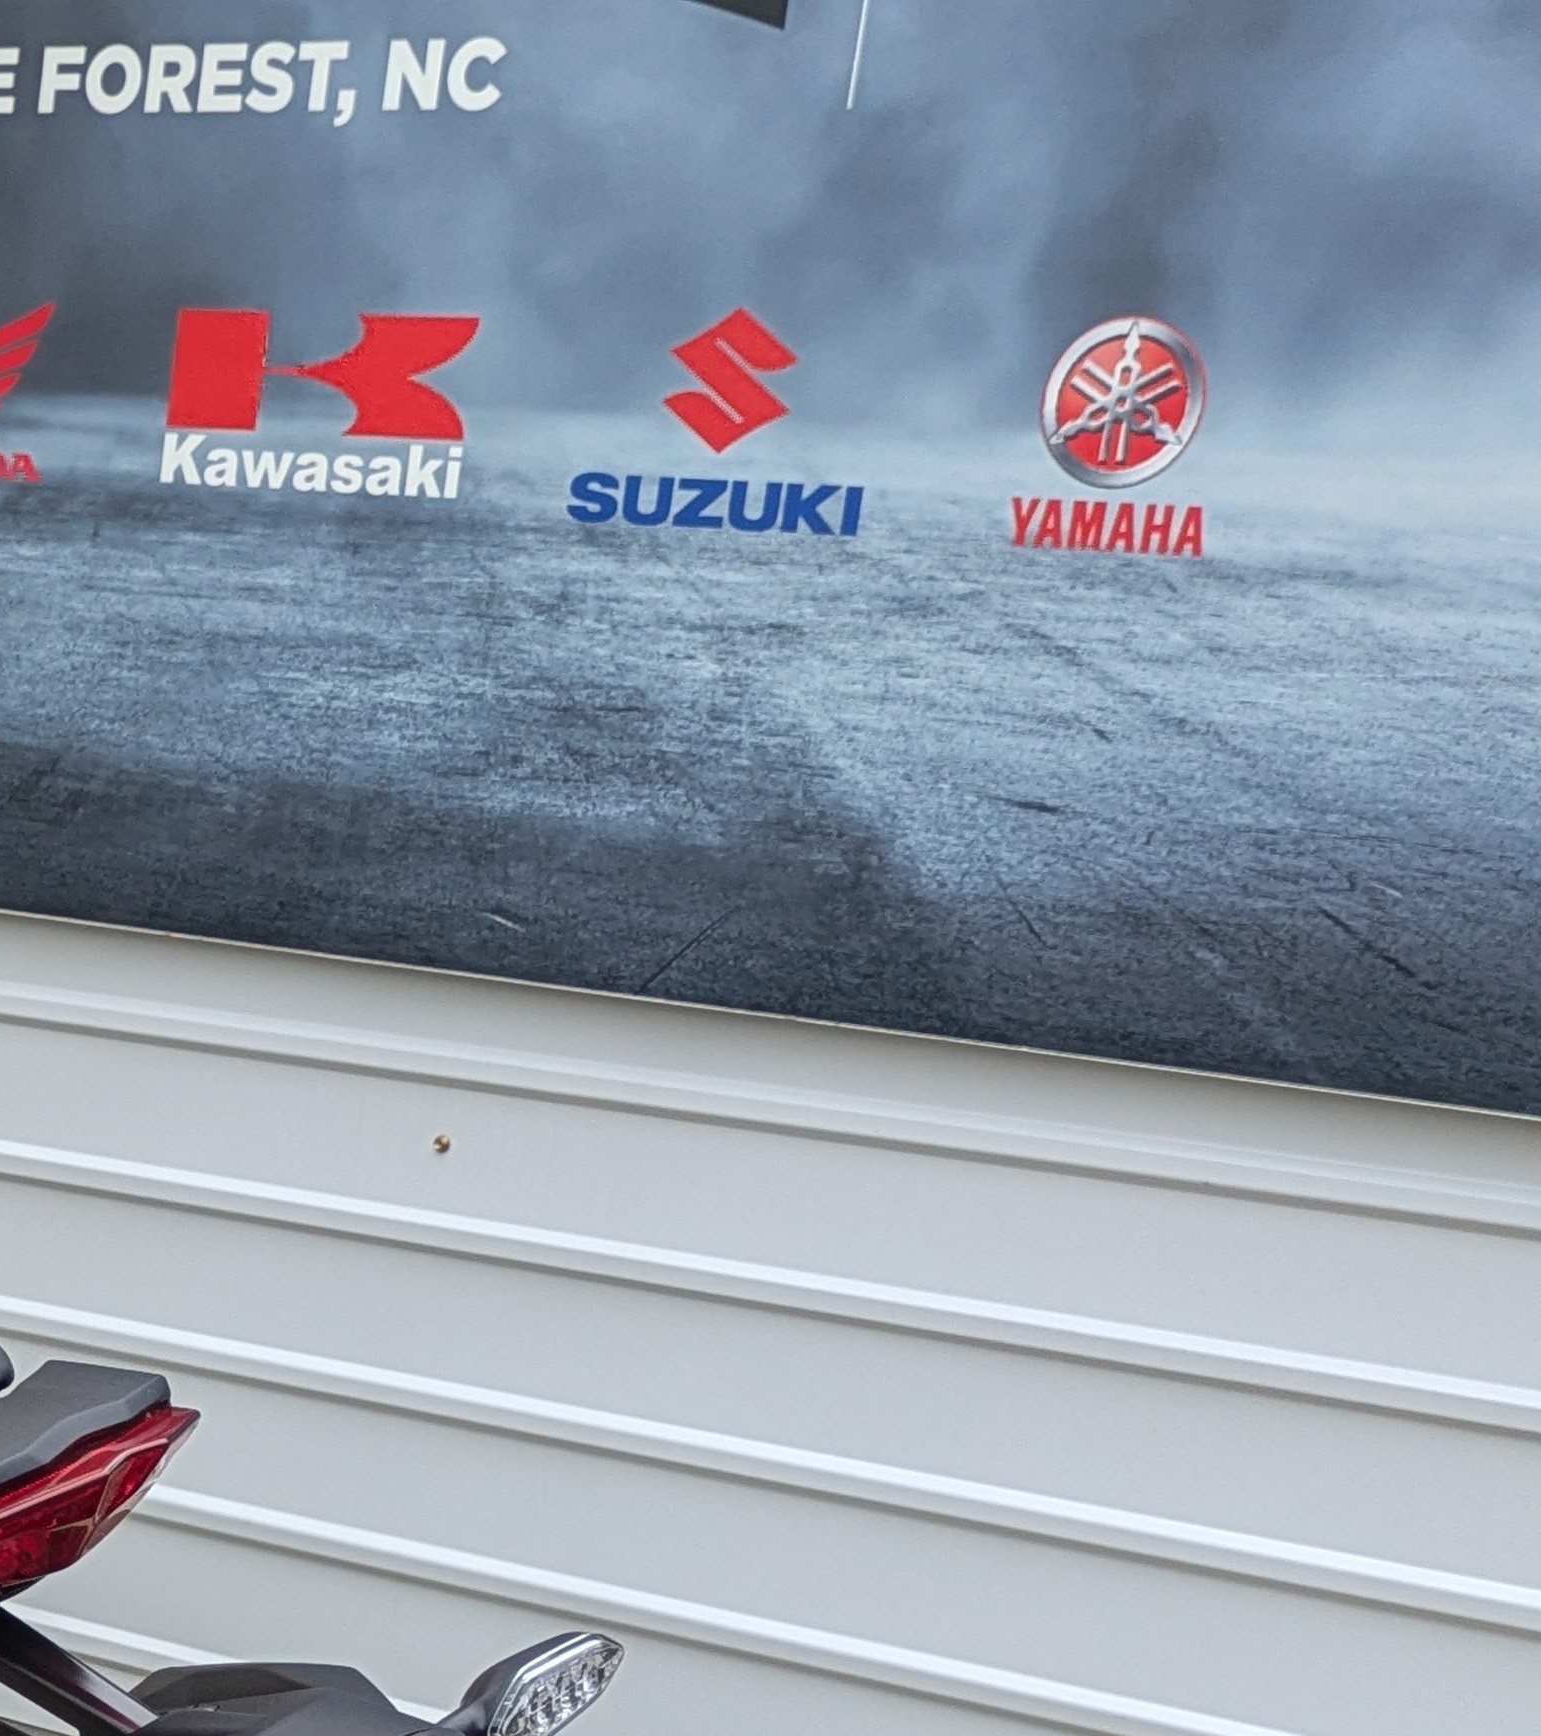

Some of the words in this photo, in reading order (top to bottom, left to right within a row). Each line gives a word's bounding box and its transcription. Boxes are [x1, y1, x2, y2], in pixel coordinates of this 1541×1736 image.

[37, 41, 355, 126] FOREST,
[381, 37, 508, 112] NC
[159, 433, 465, 500] Kawasaki
[566, 471, 863, 537] SUZUKI
[1011, 497, 1203, 557] YAMAHA
